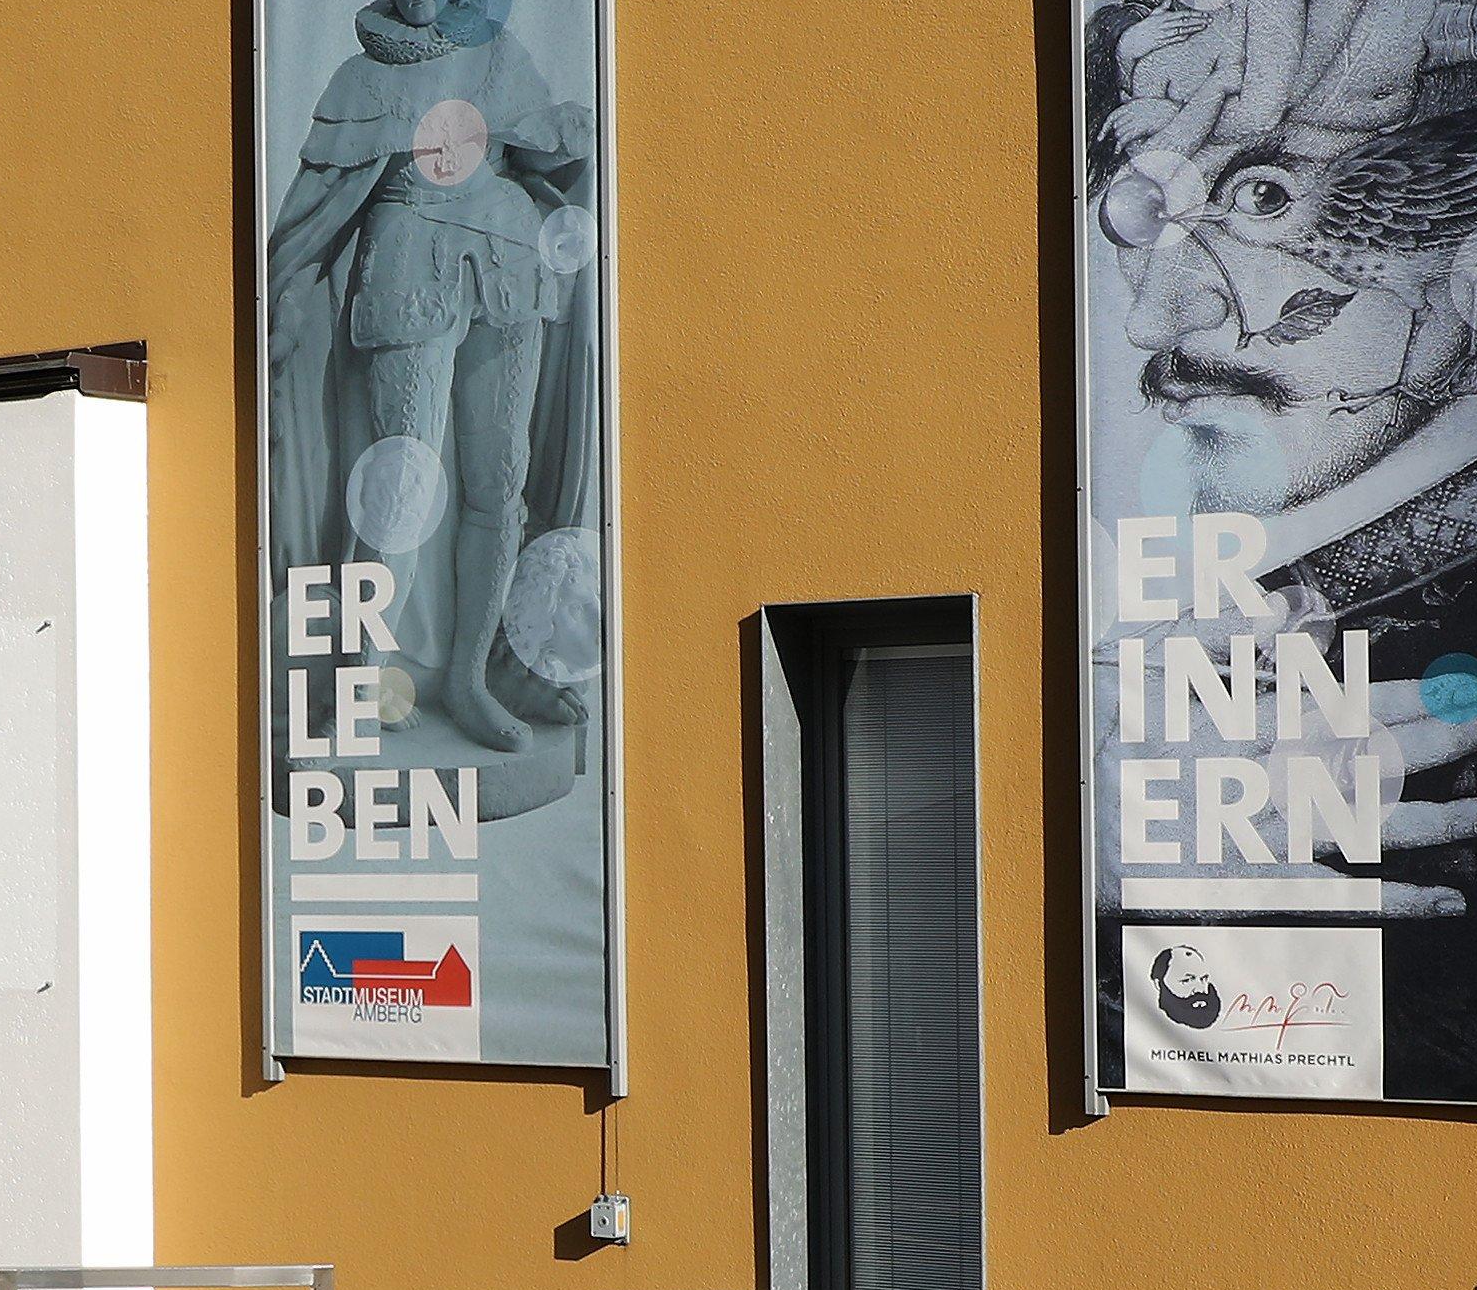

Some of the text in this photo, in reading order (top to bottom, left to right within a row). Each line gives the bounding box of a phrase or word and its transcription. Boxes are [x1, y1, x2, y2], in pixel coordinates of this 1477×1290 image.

[287, 560, 400, 657] ER
[1117, 511, 1270, 622] ER
[287, 666, 381, 759] LE
[1119, 630, 1372, 744] INN
[288, 767, 479, 861] BEN
[1120, 755, 1383, 865] ERN
[303, 986, 424, 1006] STADTMUSEUM
[353, 1004, 423, 1023] AMBERG
[1150, 1049, 1355, 1067] MICHAEL MATHIAS PRECHTL
